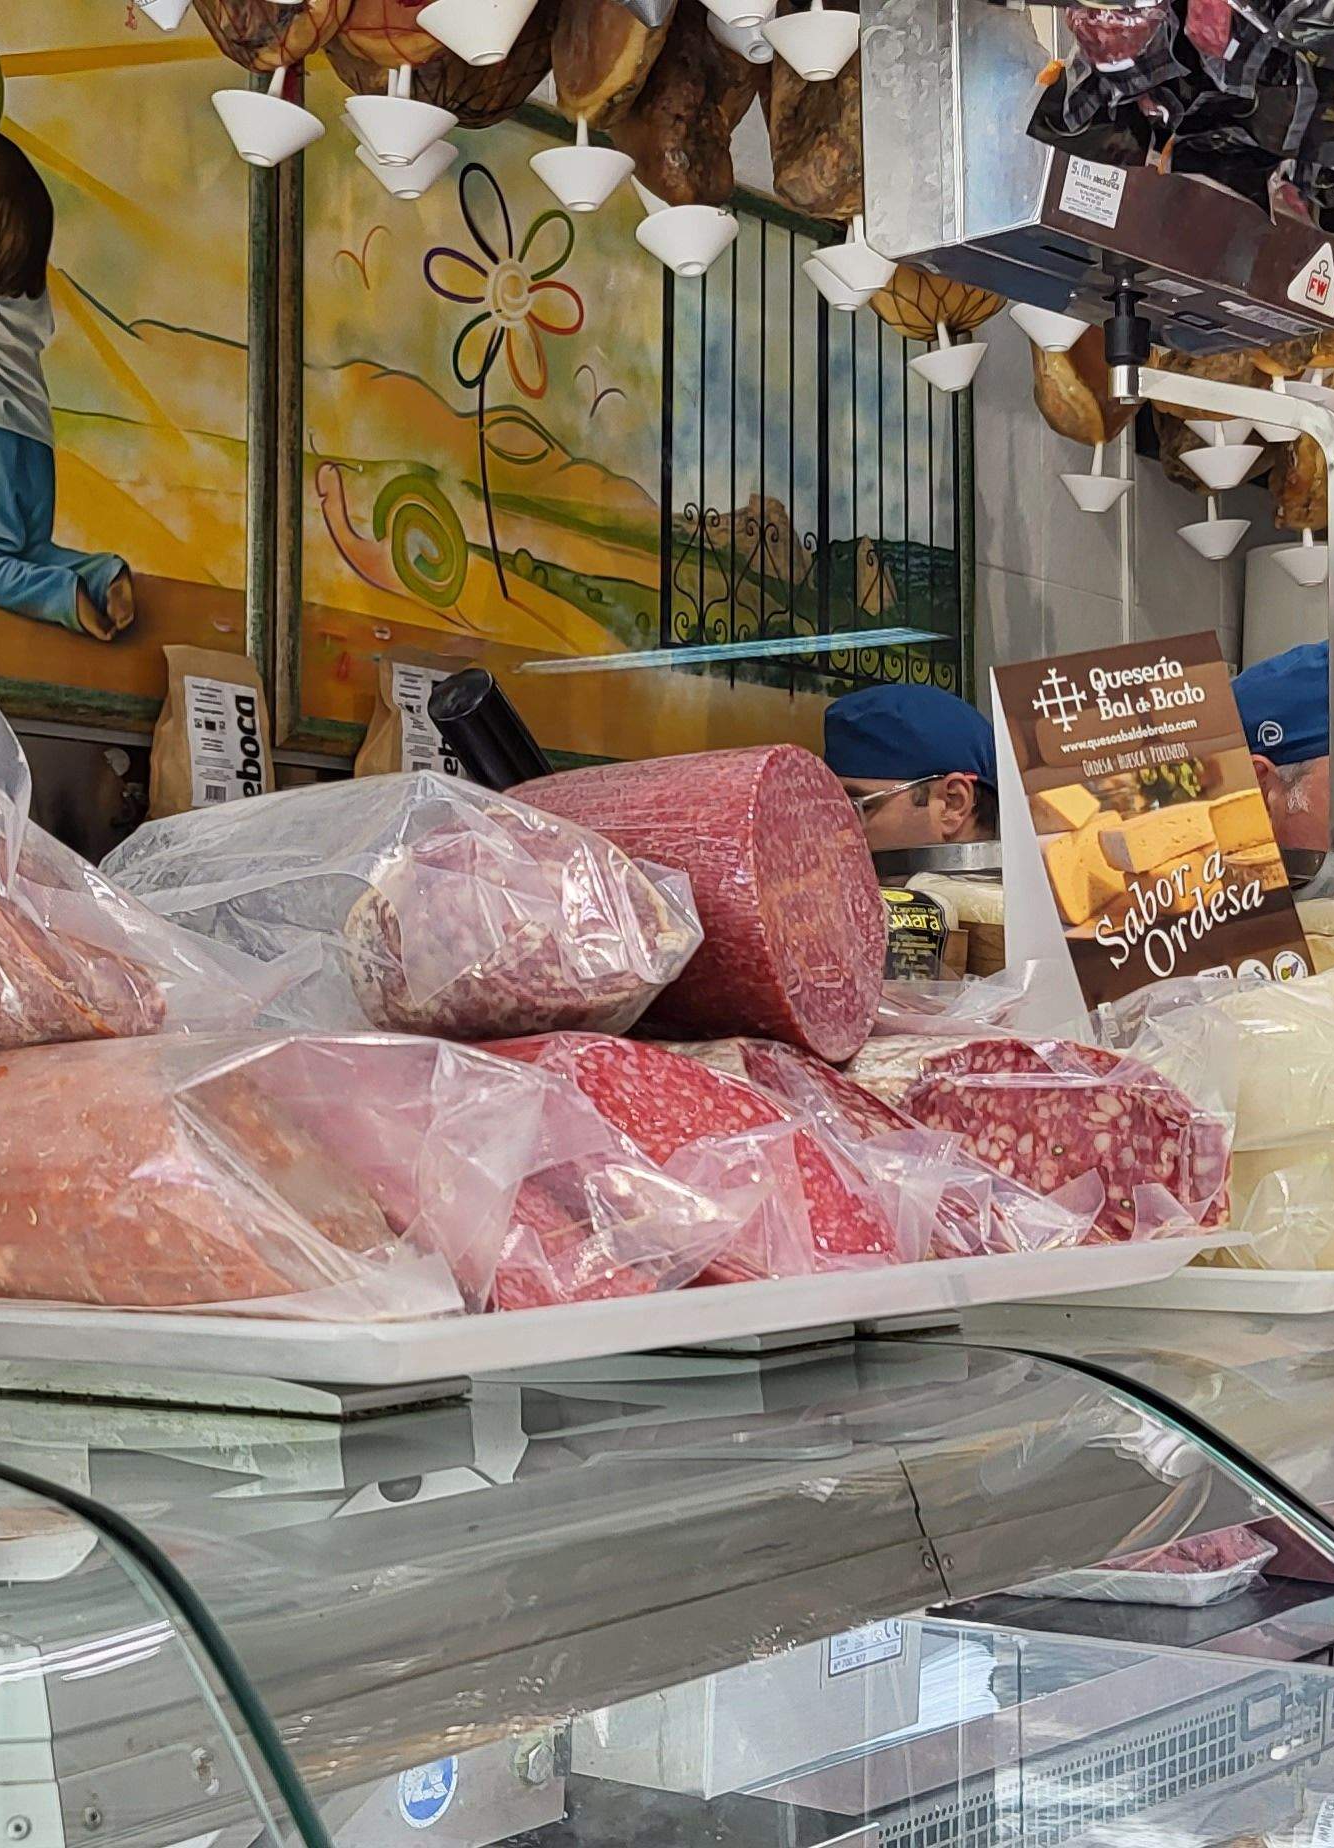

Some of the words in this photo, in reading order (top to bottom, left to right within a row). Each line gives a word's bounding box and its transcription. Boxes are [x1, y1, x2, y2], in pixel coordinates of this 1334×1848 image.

[1309, 277, 1328, 298] FW
[1089, 656, 1184, 697] Quesería
[1096, 693, 1135, 721] Bal
[1136, 696, 1152, 714] de
[1149, 682, 1206, 712] Broto
[1060, 718, 1198, 754] www.quesosbaldebroto.com
[1094, 861, 1192, 971] Sabor
[1202, 850, 1227, 884] a
[1144, 879, 1266, 978] Ordesa
